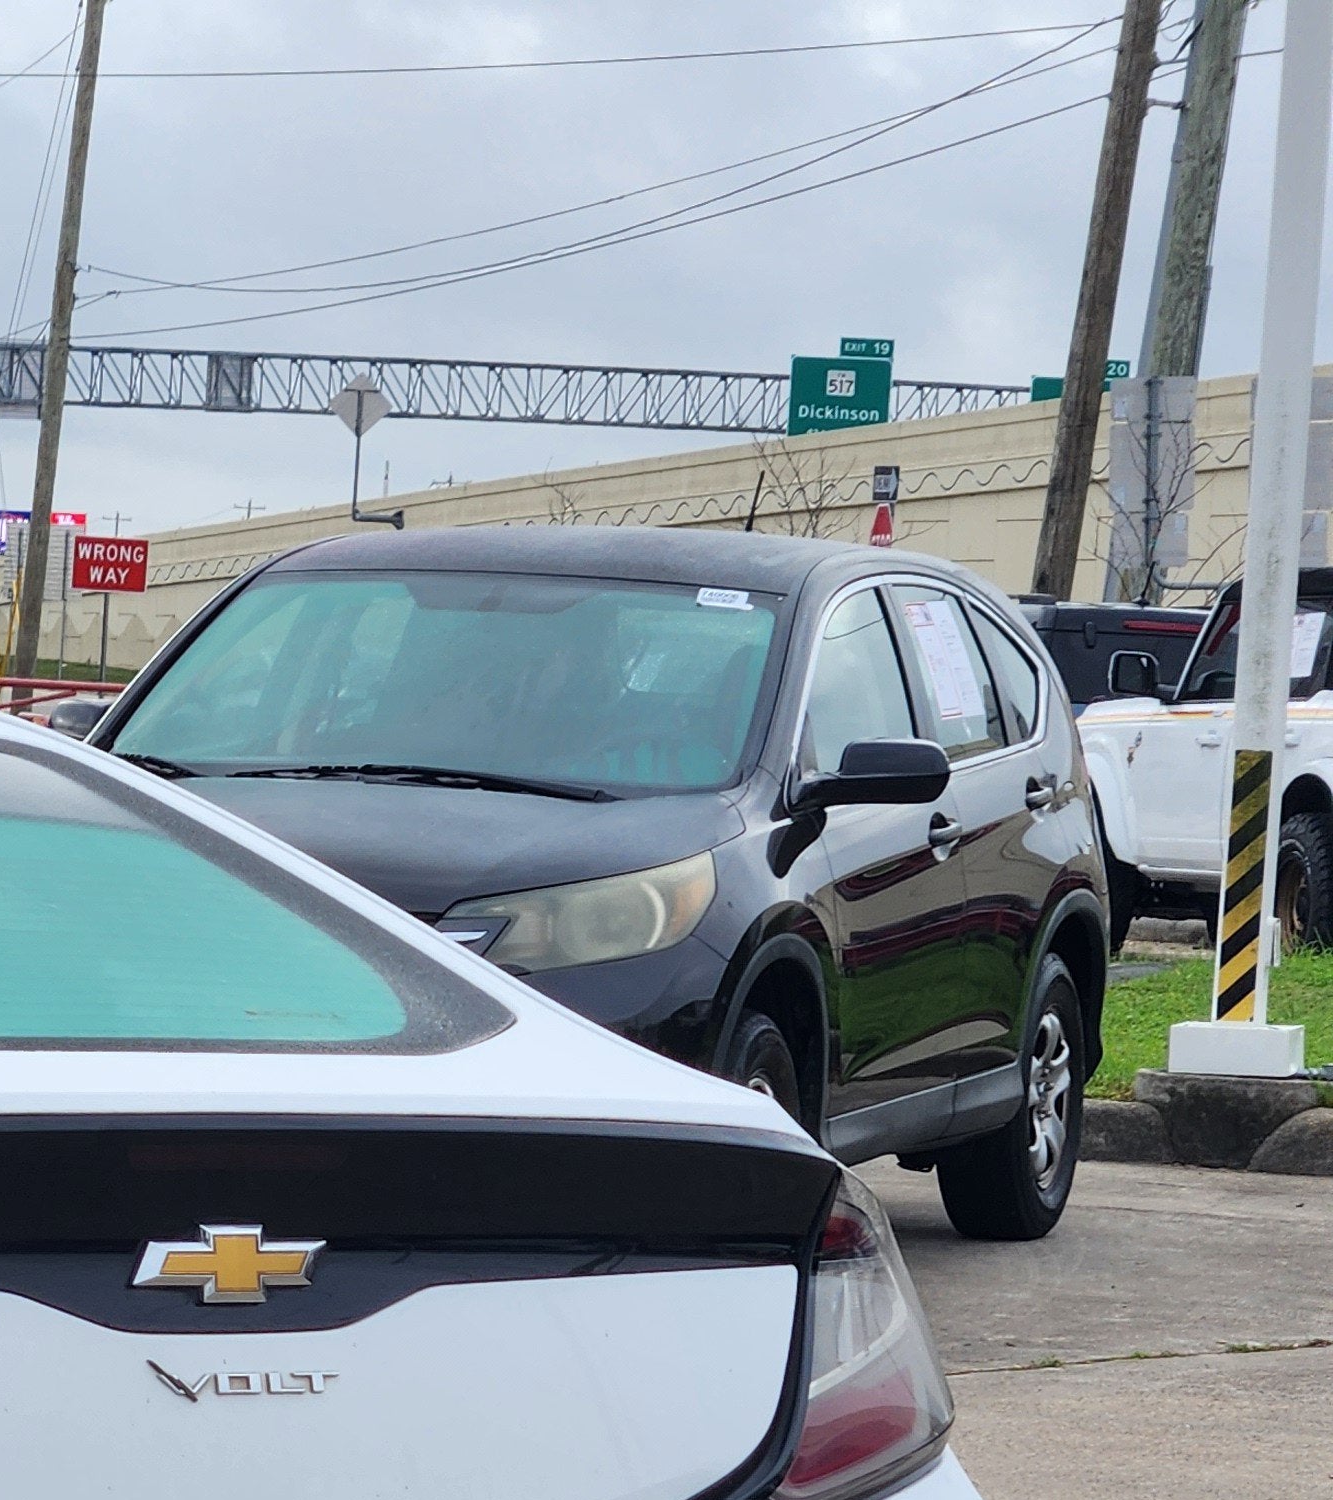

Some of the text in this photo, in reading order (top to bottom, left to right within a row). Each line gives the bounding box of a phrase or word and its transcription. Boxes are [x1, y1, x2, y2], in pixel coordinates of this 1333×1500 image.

[844, 342, 890, 355] EXIT 19
[1107, 363, 1128, 376] 20
[828, 379, 854, 394] 517
[798, 404, 880, 422] Dickinson
[78, 543, 145, 564] WRONG
[89, 566, 130, 584] WAY
[146, 1359, 341, 1402] VOLT
